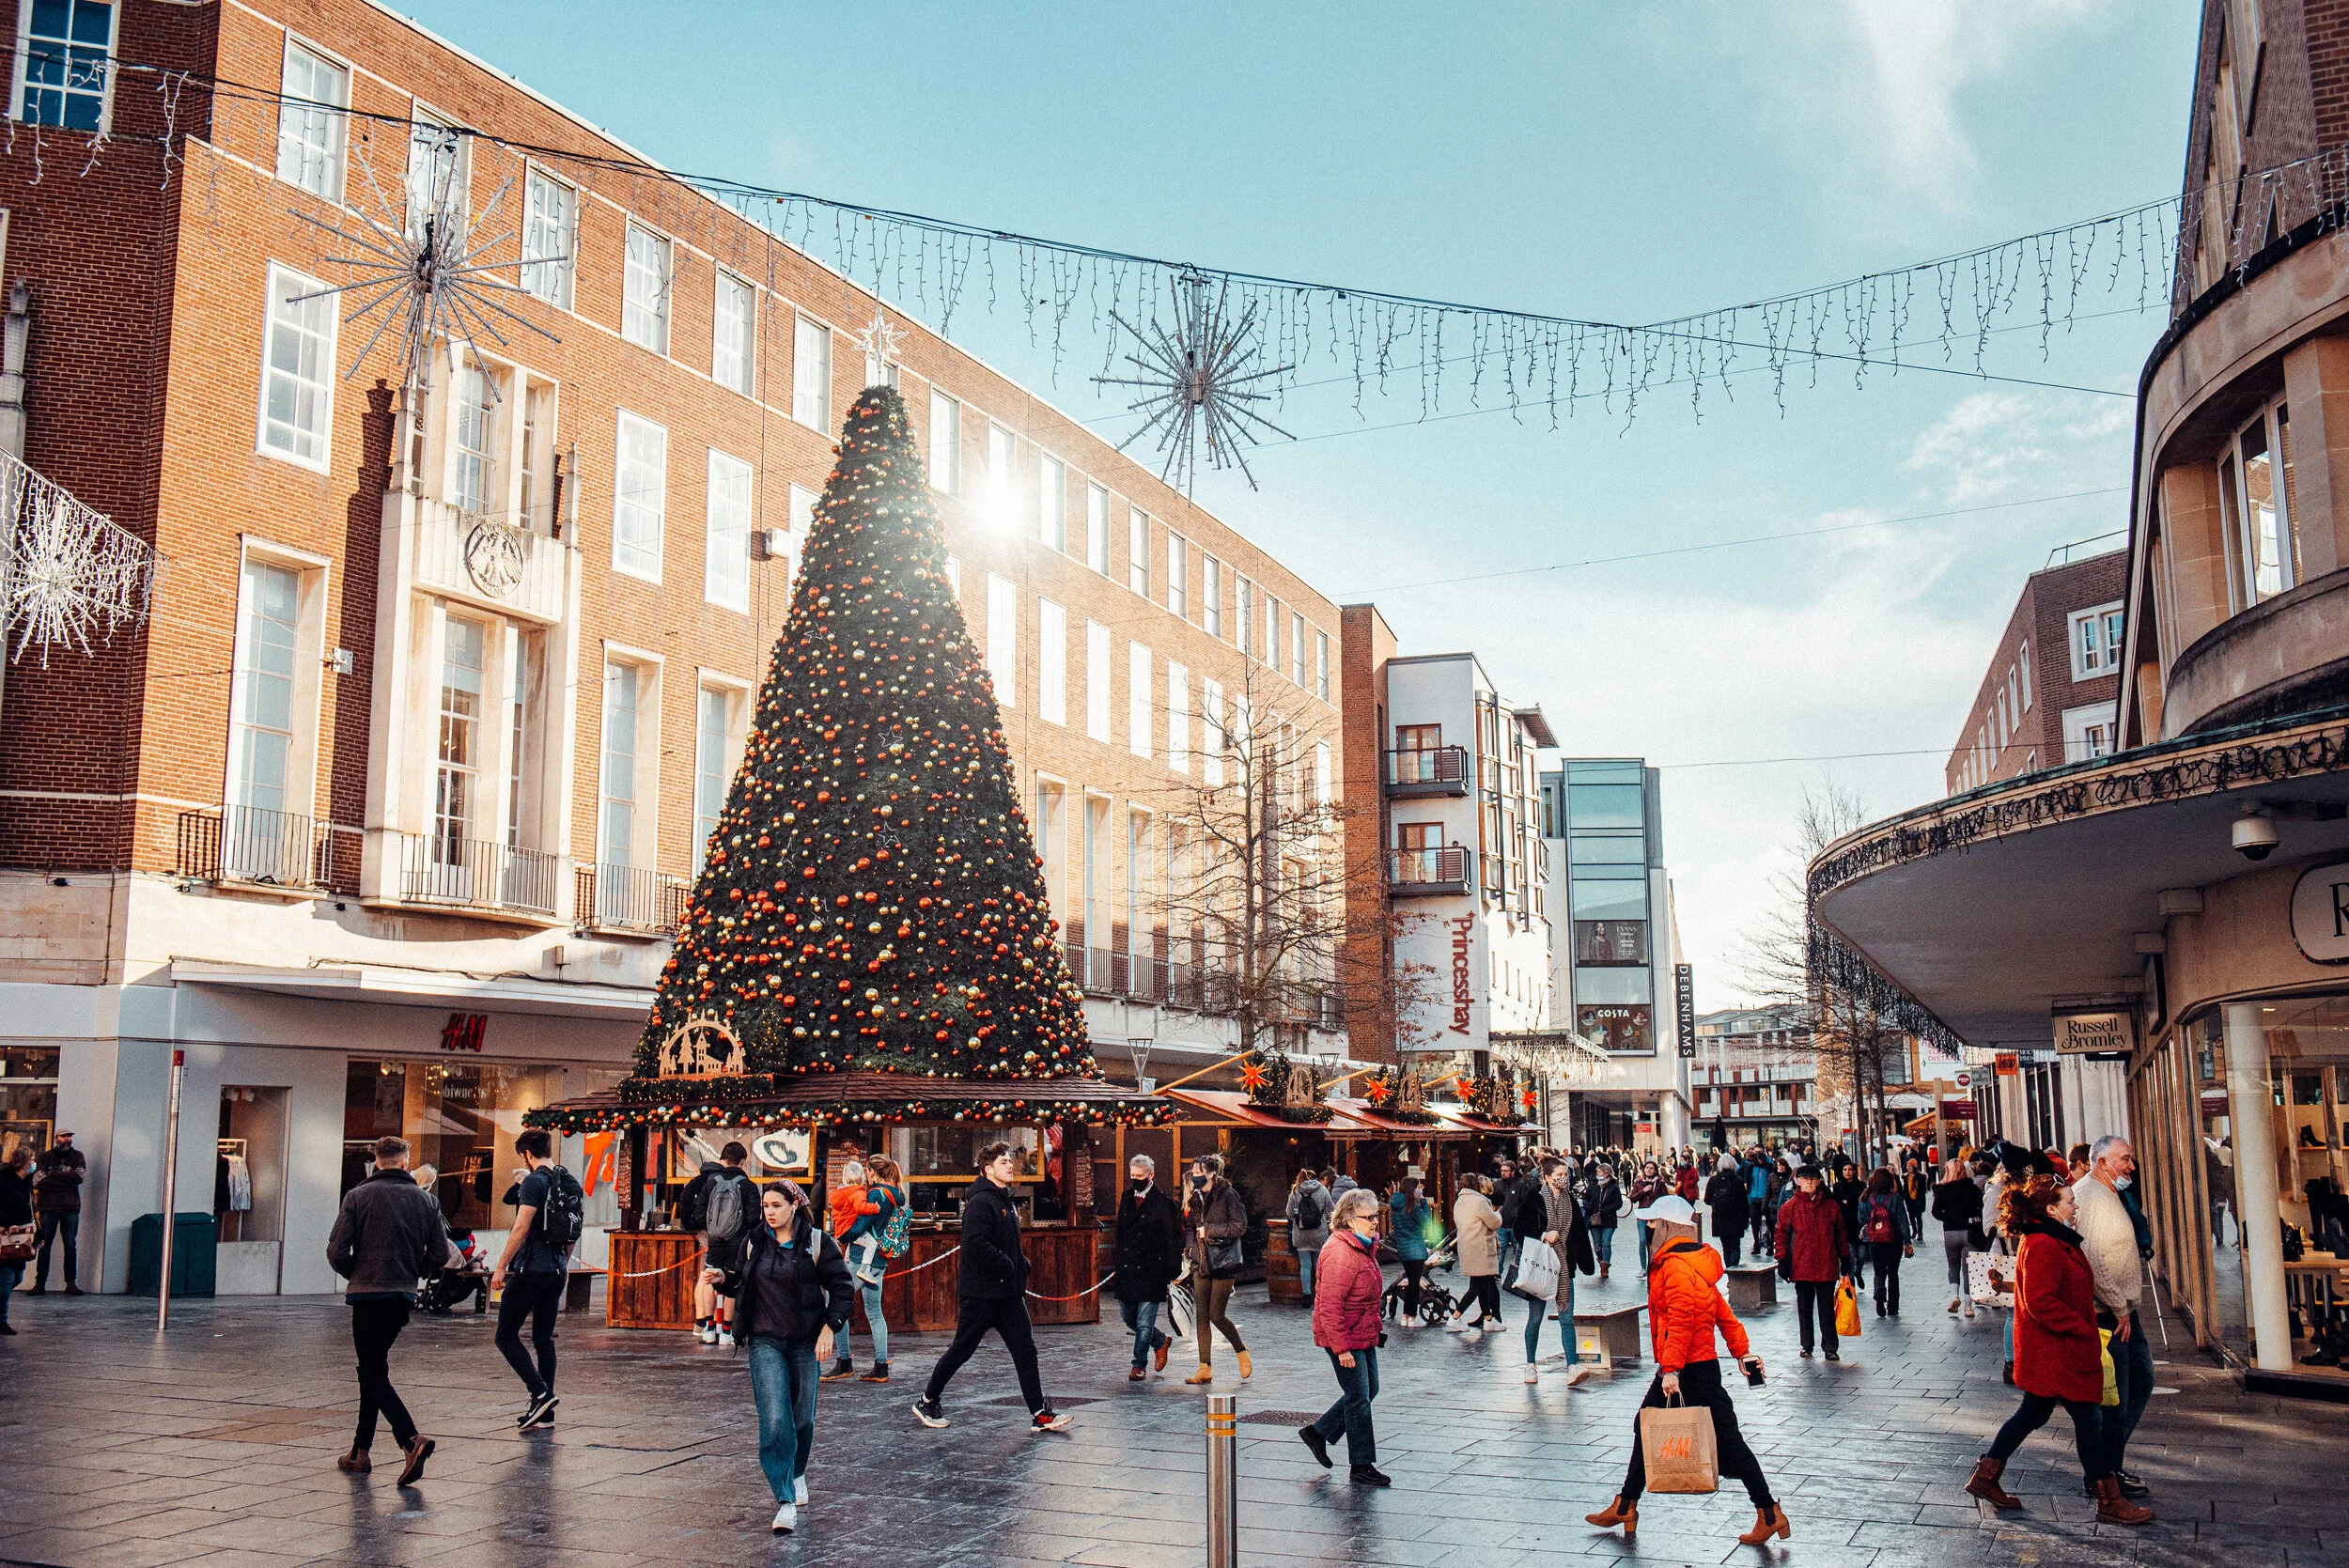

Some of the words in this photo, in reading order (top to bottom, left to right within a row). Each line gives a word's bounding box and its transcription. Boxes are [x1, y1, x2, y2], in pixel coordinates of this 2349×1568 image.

[1449, 916, 1475, 1035] Princesshay
[1597, 1009, 1630, 1018] COSTA
[1679, 966, 1692, 1056] DEBENHAMS
[2067, 1017, 2118, 1034] Russell
[441, 1013, 488, 1052] H&M
[1659, 1436, 1690, 1460] H&M
